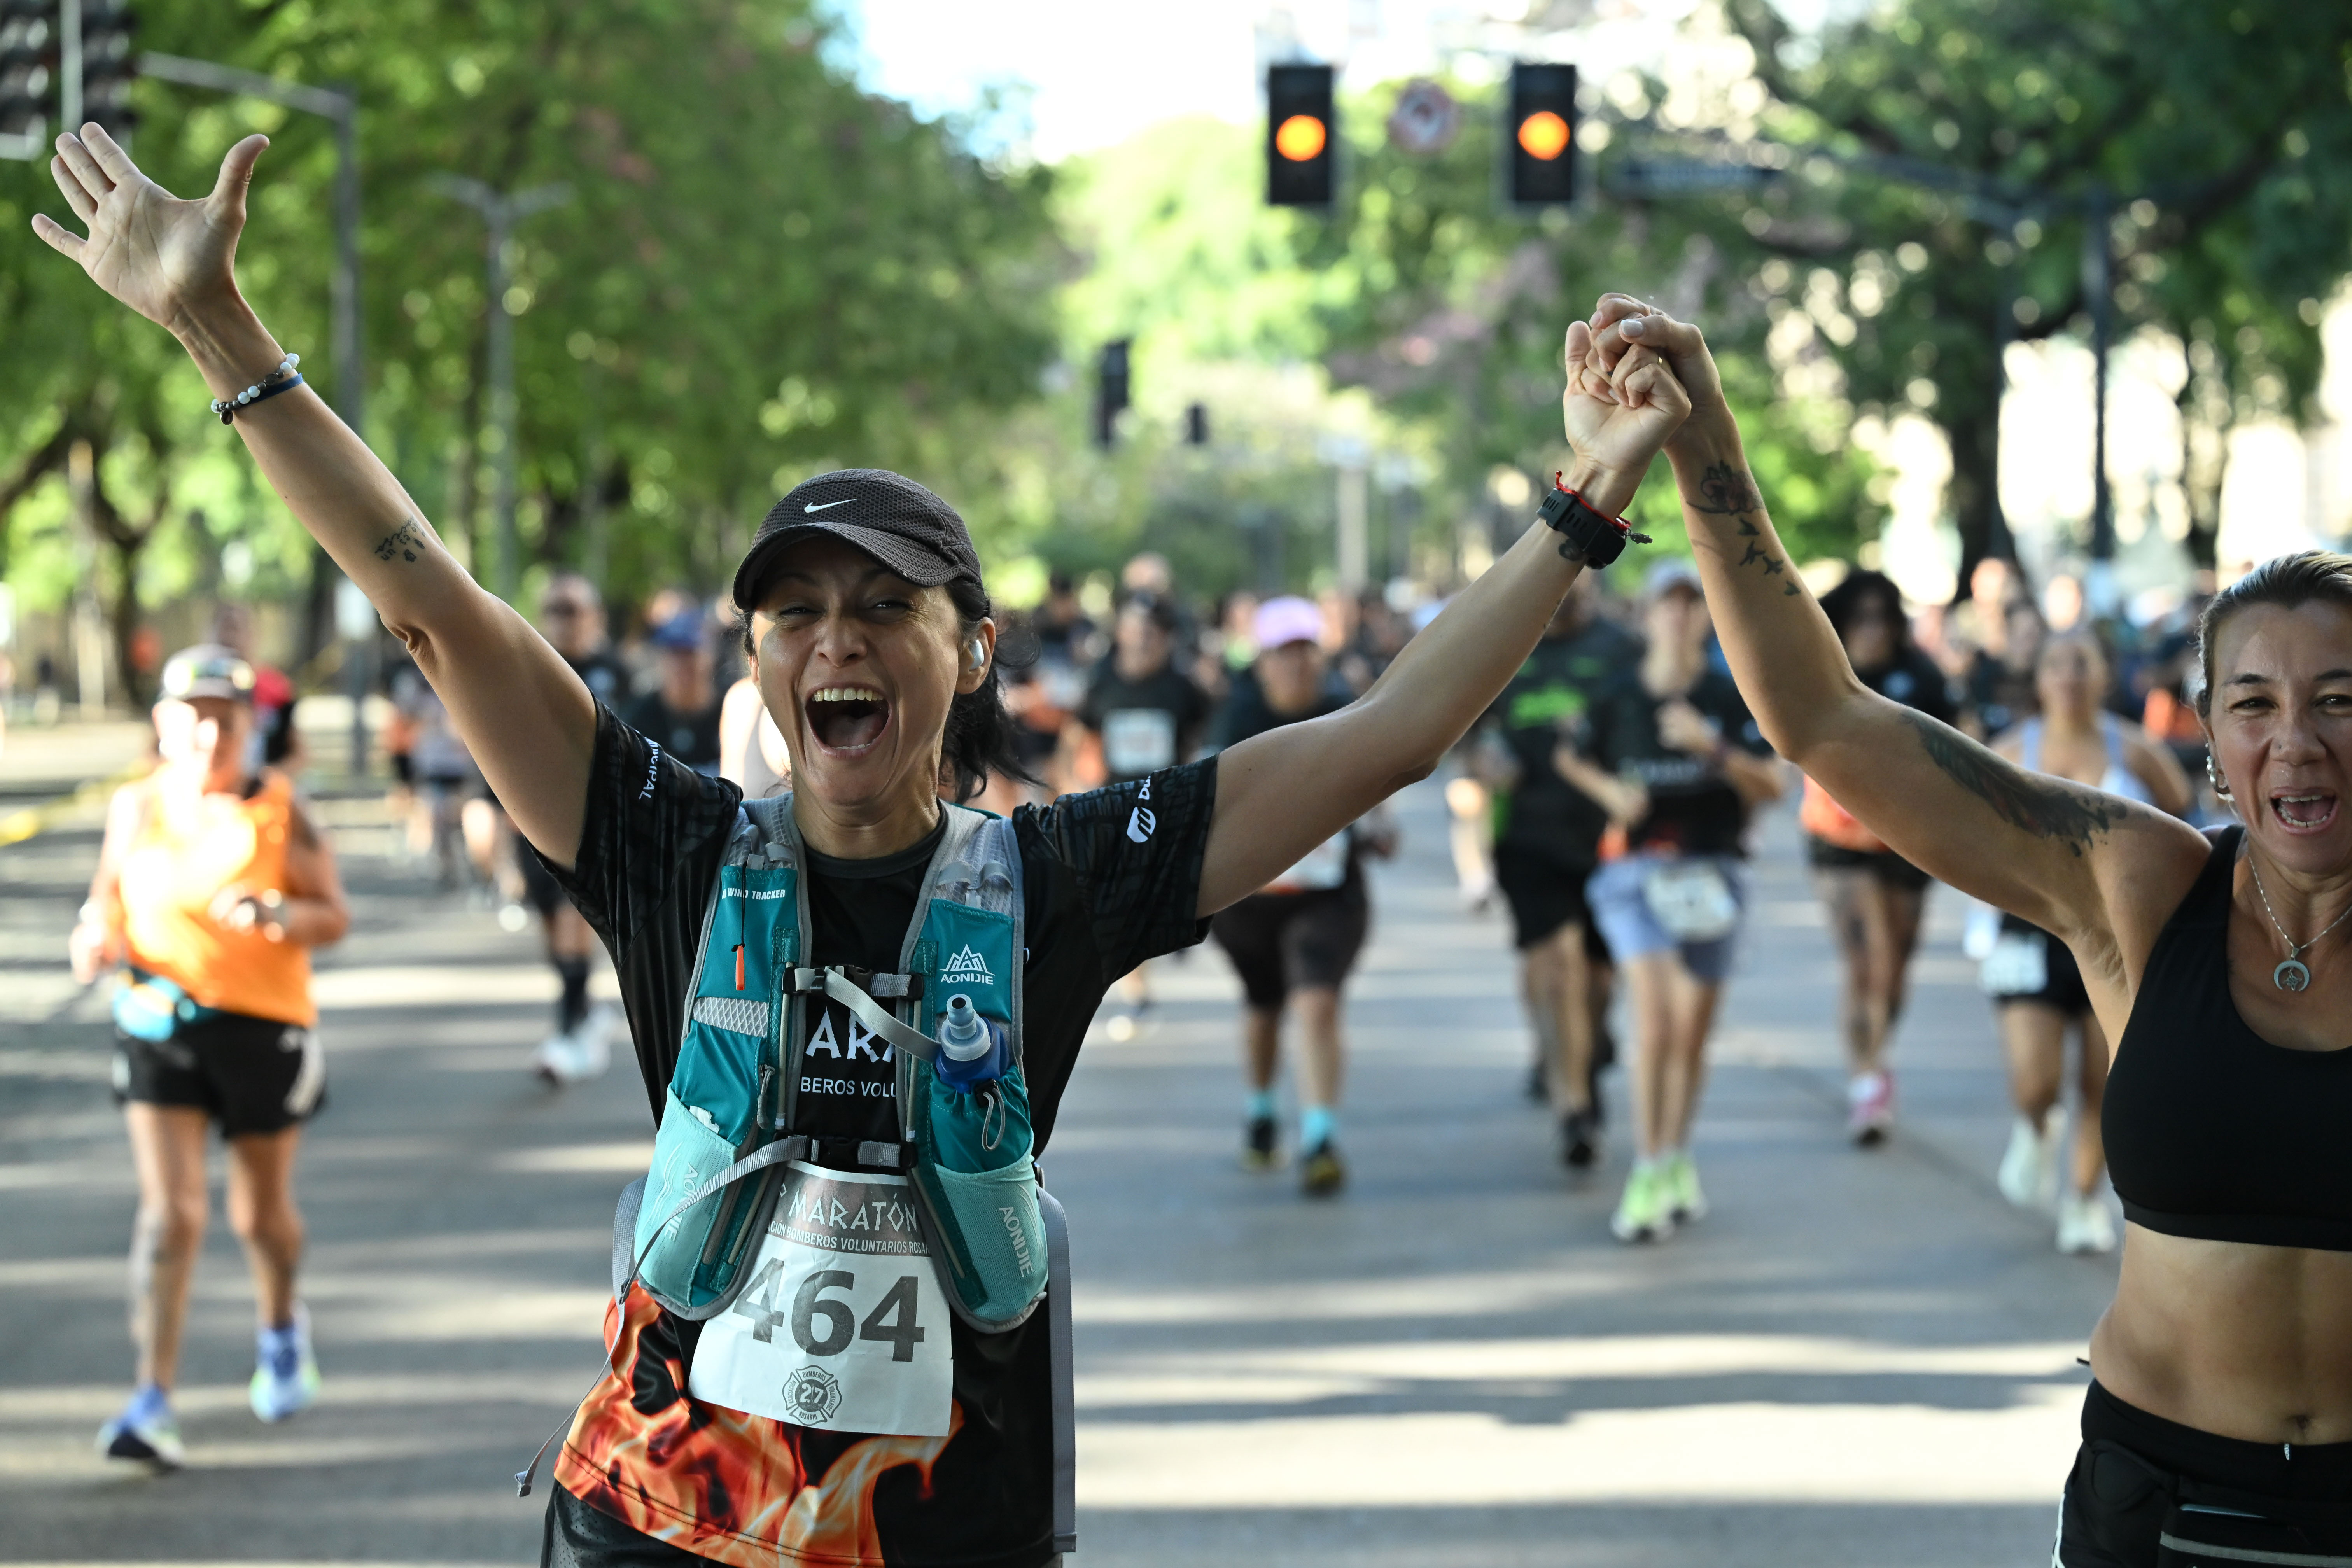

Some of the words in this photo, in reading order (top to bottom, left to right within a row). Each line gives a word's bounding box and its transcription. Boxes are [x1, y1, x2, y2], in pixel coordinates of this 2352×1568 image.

[752, 889, 786, 900] TRACKER
[941, 973, 993, 985] AONIJIE
[801, 1076, 855, 1095] BEROS
[788, 1188, 917, 1232] MARATÓN
[768, 1220, 786, 1237] CIÓN
[786, 1226, 837, 1249] BOMBEROS
[841, 1237, 907, 1253] VOLUNTARIOS
[999, 1207, 1033, 1278] AONIJIE
[732, 1256, 925, 1362] 464
[802, 1370, 827, 1381] BOMBEROS
[800, 1382, 824, 1404] 27
[798, 1411, 817, 1420] ROSARIO
